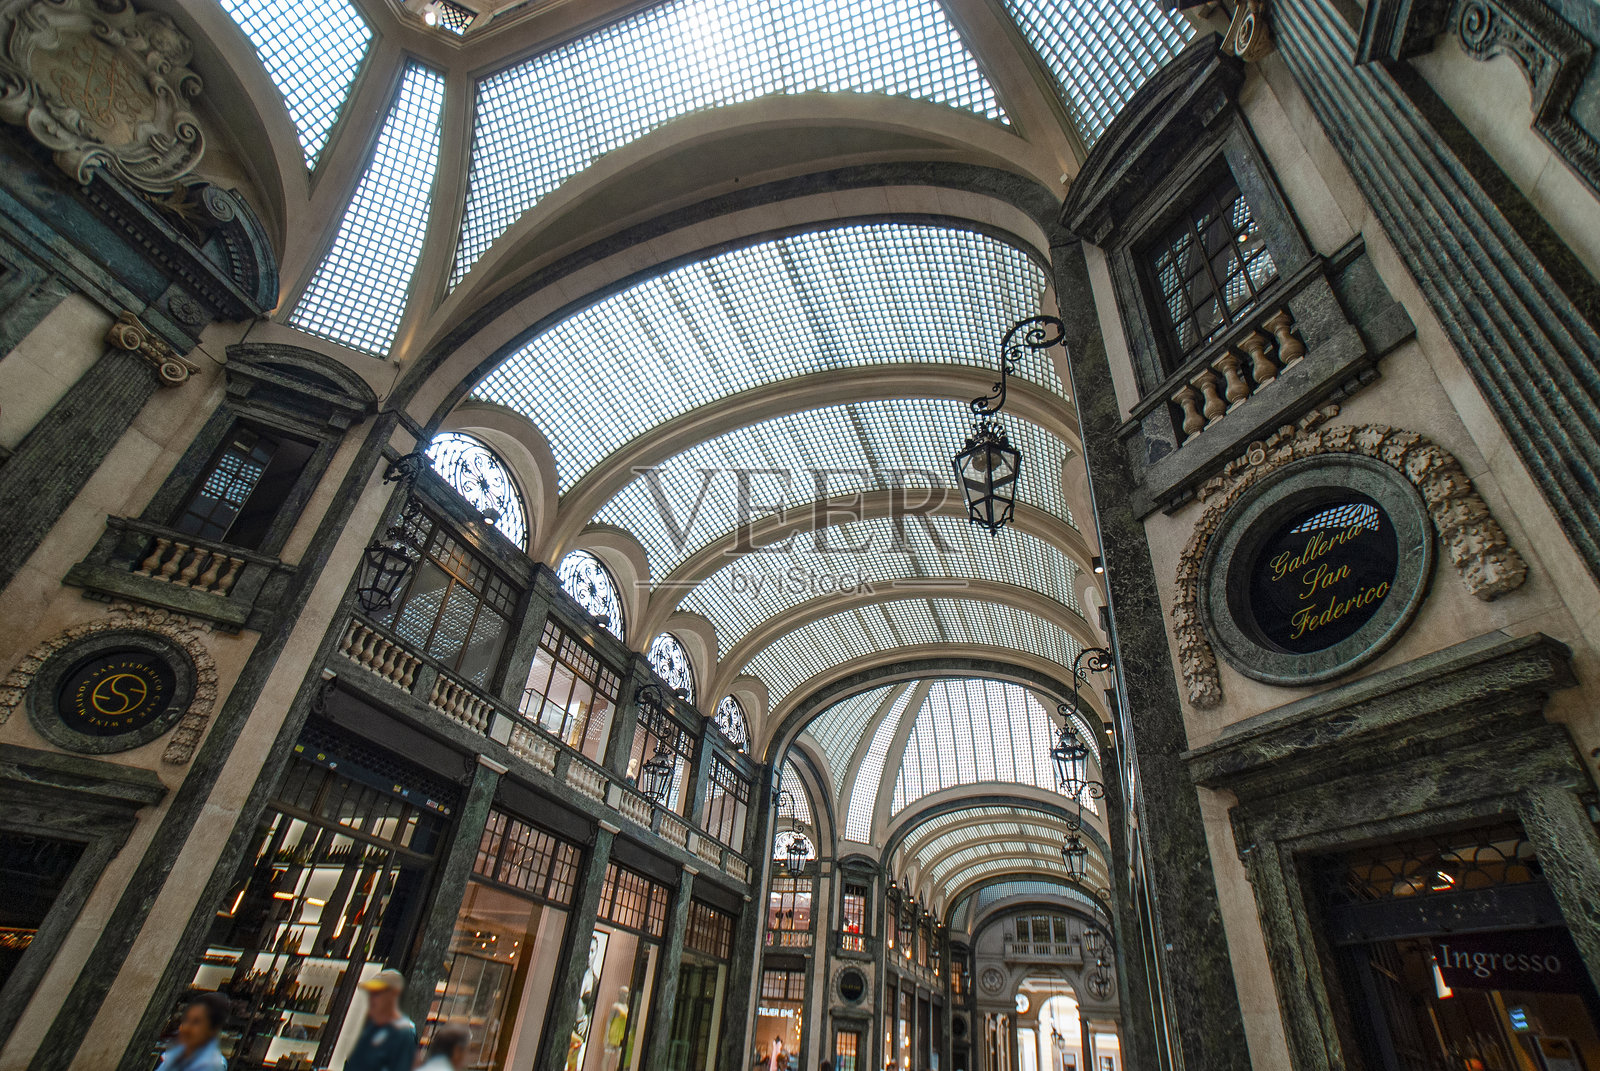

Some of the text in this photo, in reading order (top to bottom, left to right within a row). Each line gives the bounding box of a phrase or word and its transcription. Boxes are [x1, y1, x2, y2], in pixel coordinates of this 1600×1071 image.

[1269, 523, 1363, 581] Galleria
[1299, 564, 1351, 600] San
[1290, 580, 1390, 640] Federico
[1439, 943, 1561, 979] Ingresso
[757, 1006, 779, 1017] TELIER
